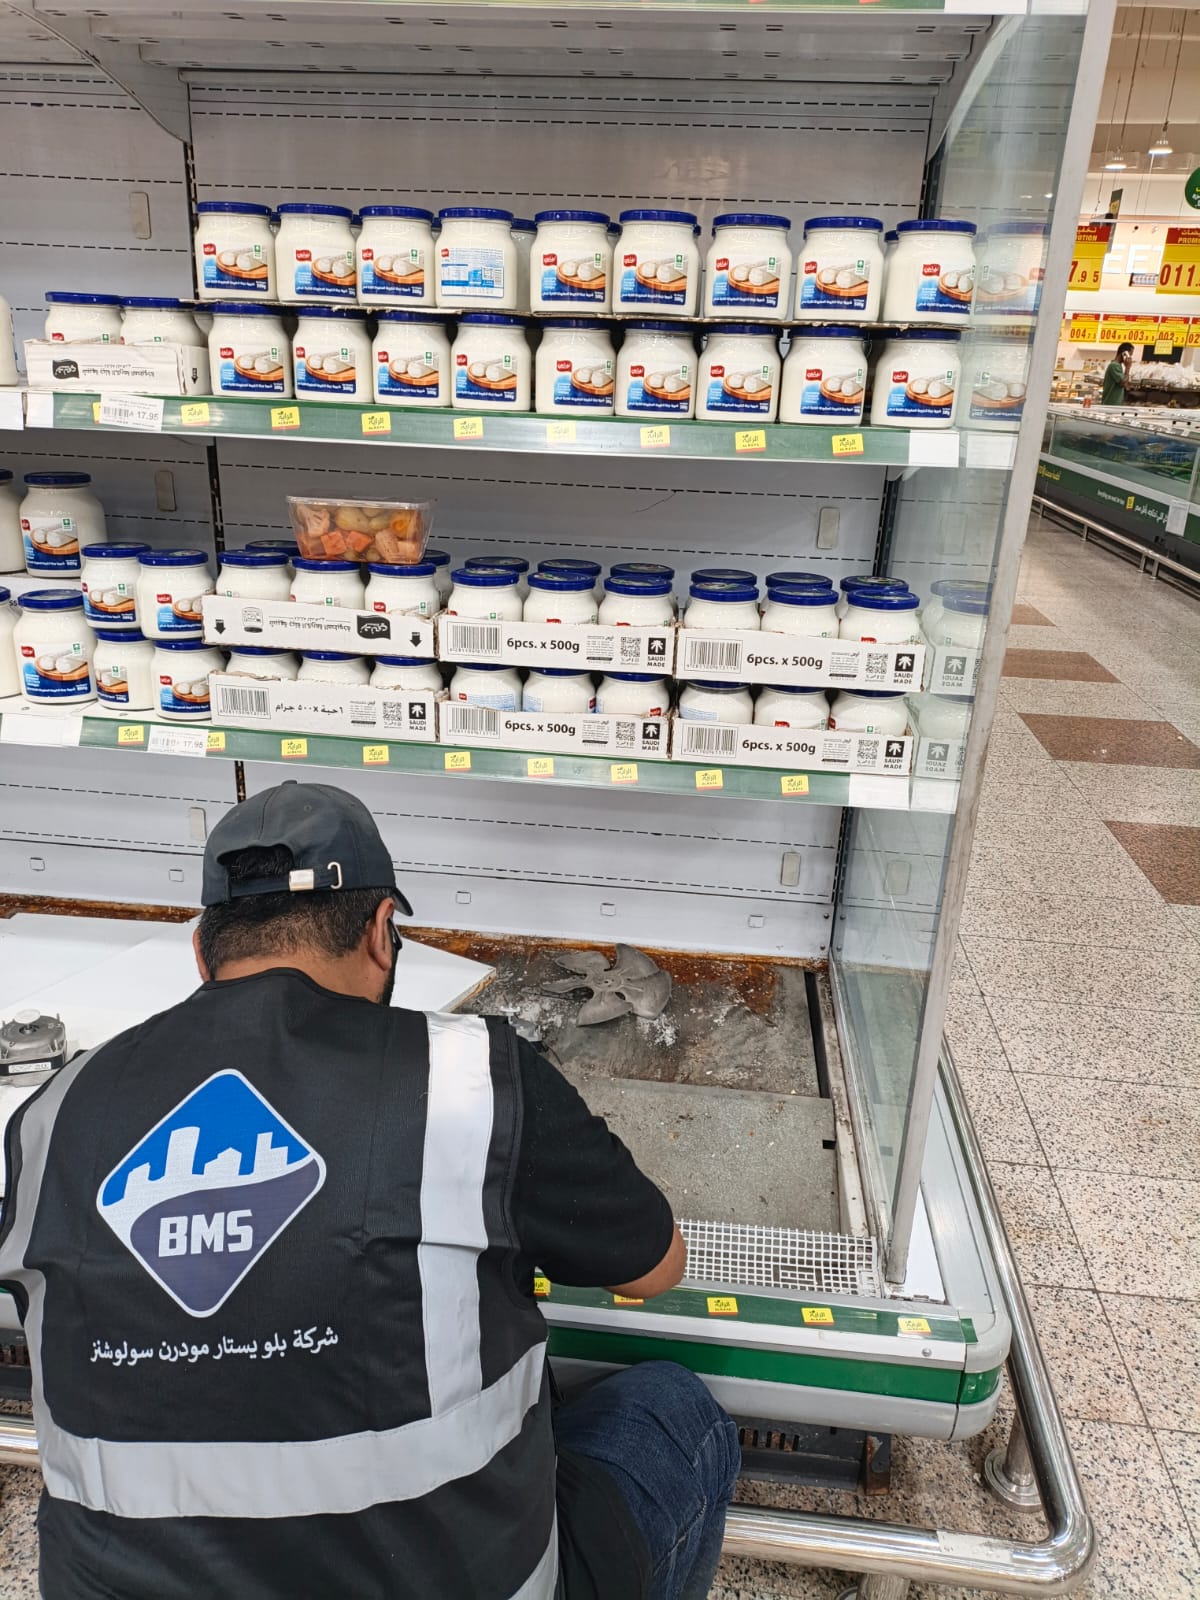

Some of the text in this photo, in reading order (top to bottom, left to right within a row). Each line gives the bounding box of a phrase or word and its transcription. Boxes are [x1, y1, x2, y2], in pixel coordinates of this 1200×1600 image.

[507, 638, 580, 653] 6pcs. x 500g
[746, 653, 779, 665] 6pcs.
[791, 656, 823, 670] 500g
[275, 702, 295, 712] جرام
[504, 720, 535, 732] 6pcs.
[537, 724, 544, 732] x
[546, 722, 576, 736] 500g
[742, 739, 773, 752] 6pcs.
[776, 743, 782, 751] x
[785, 741, 816, 755] 500g
[158, 1209, 253, 1257] BMS
[90, 1327, 339, 1366] شركة بلو يستار مودرن سولوشنز
